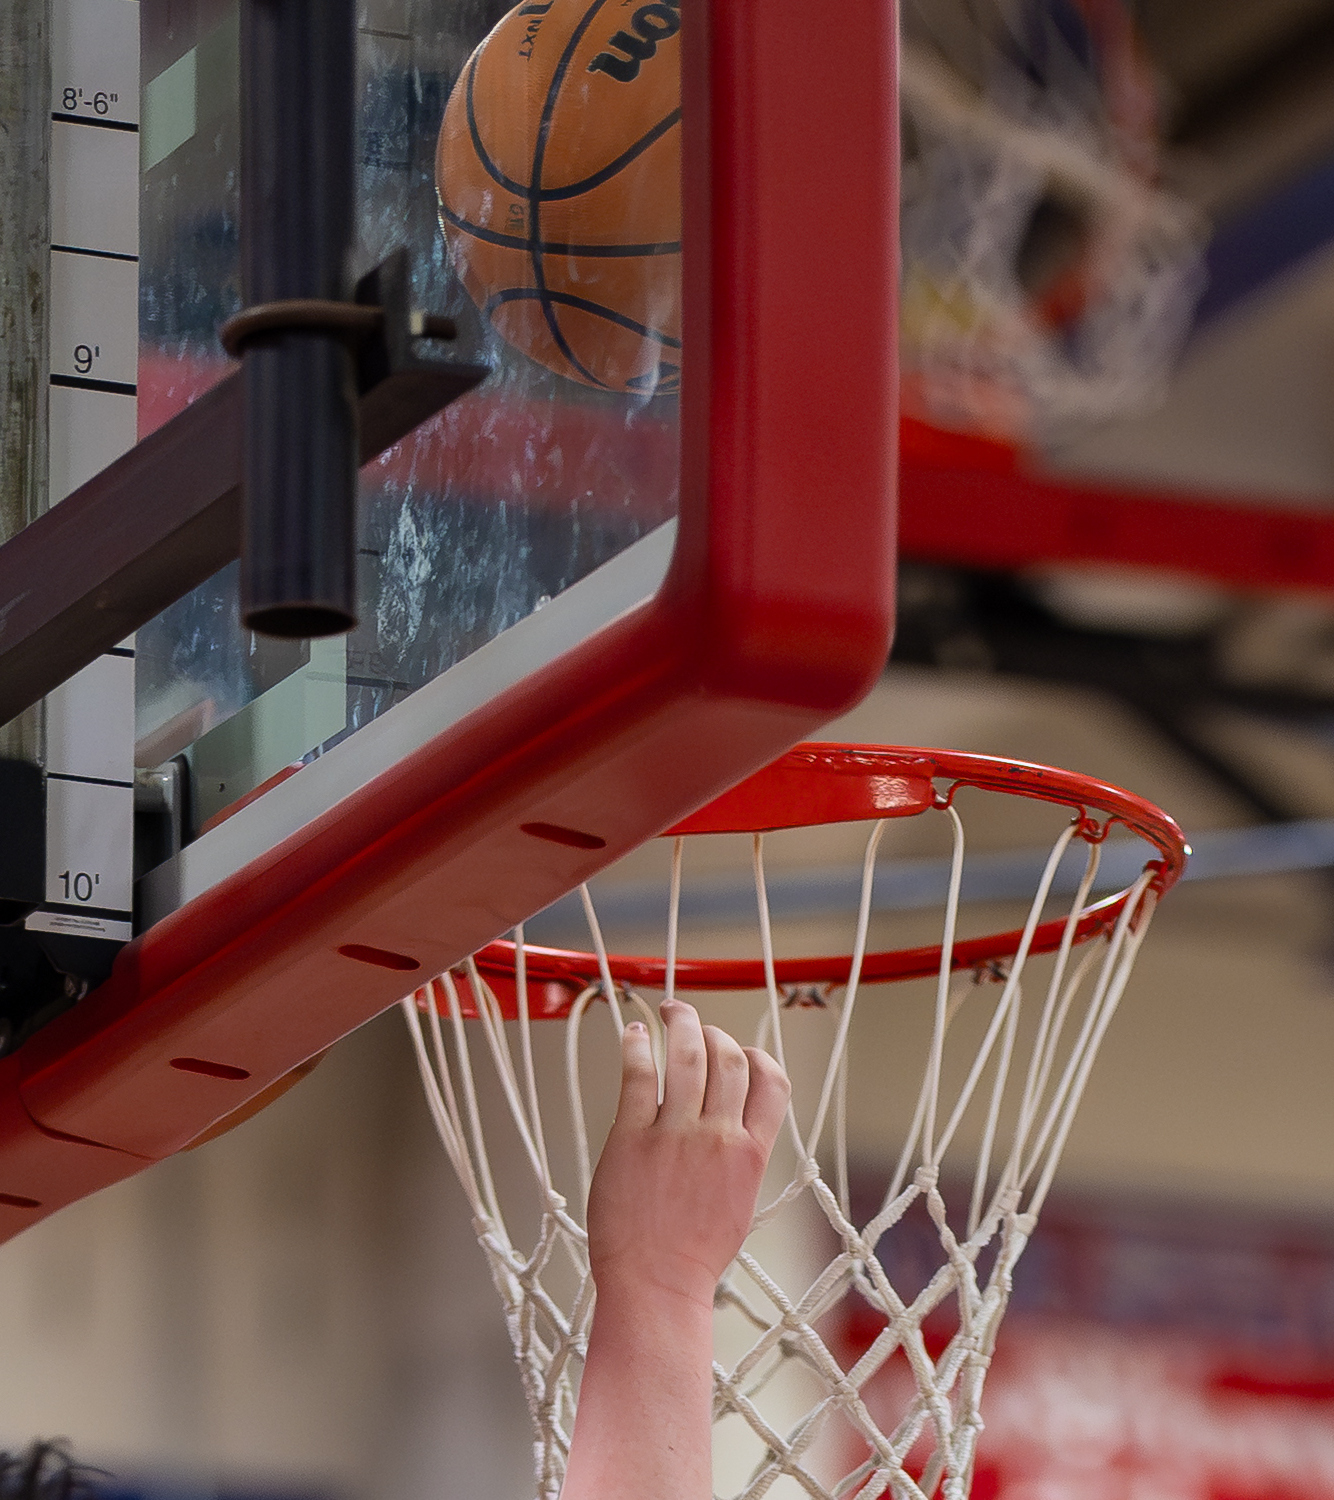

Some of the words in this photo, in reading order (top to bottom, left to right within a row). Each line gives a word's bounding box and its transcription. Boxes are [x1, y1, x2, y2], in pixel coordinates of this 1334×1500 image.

[518, 18, 545, 62] NXT
[63, 87, 118, 115] 8'-6"
[74, 344, 100, 374] 9'
[58, 870, 100, 902] 10'
